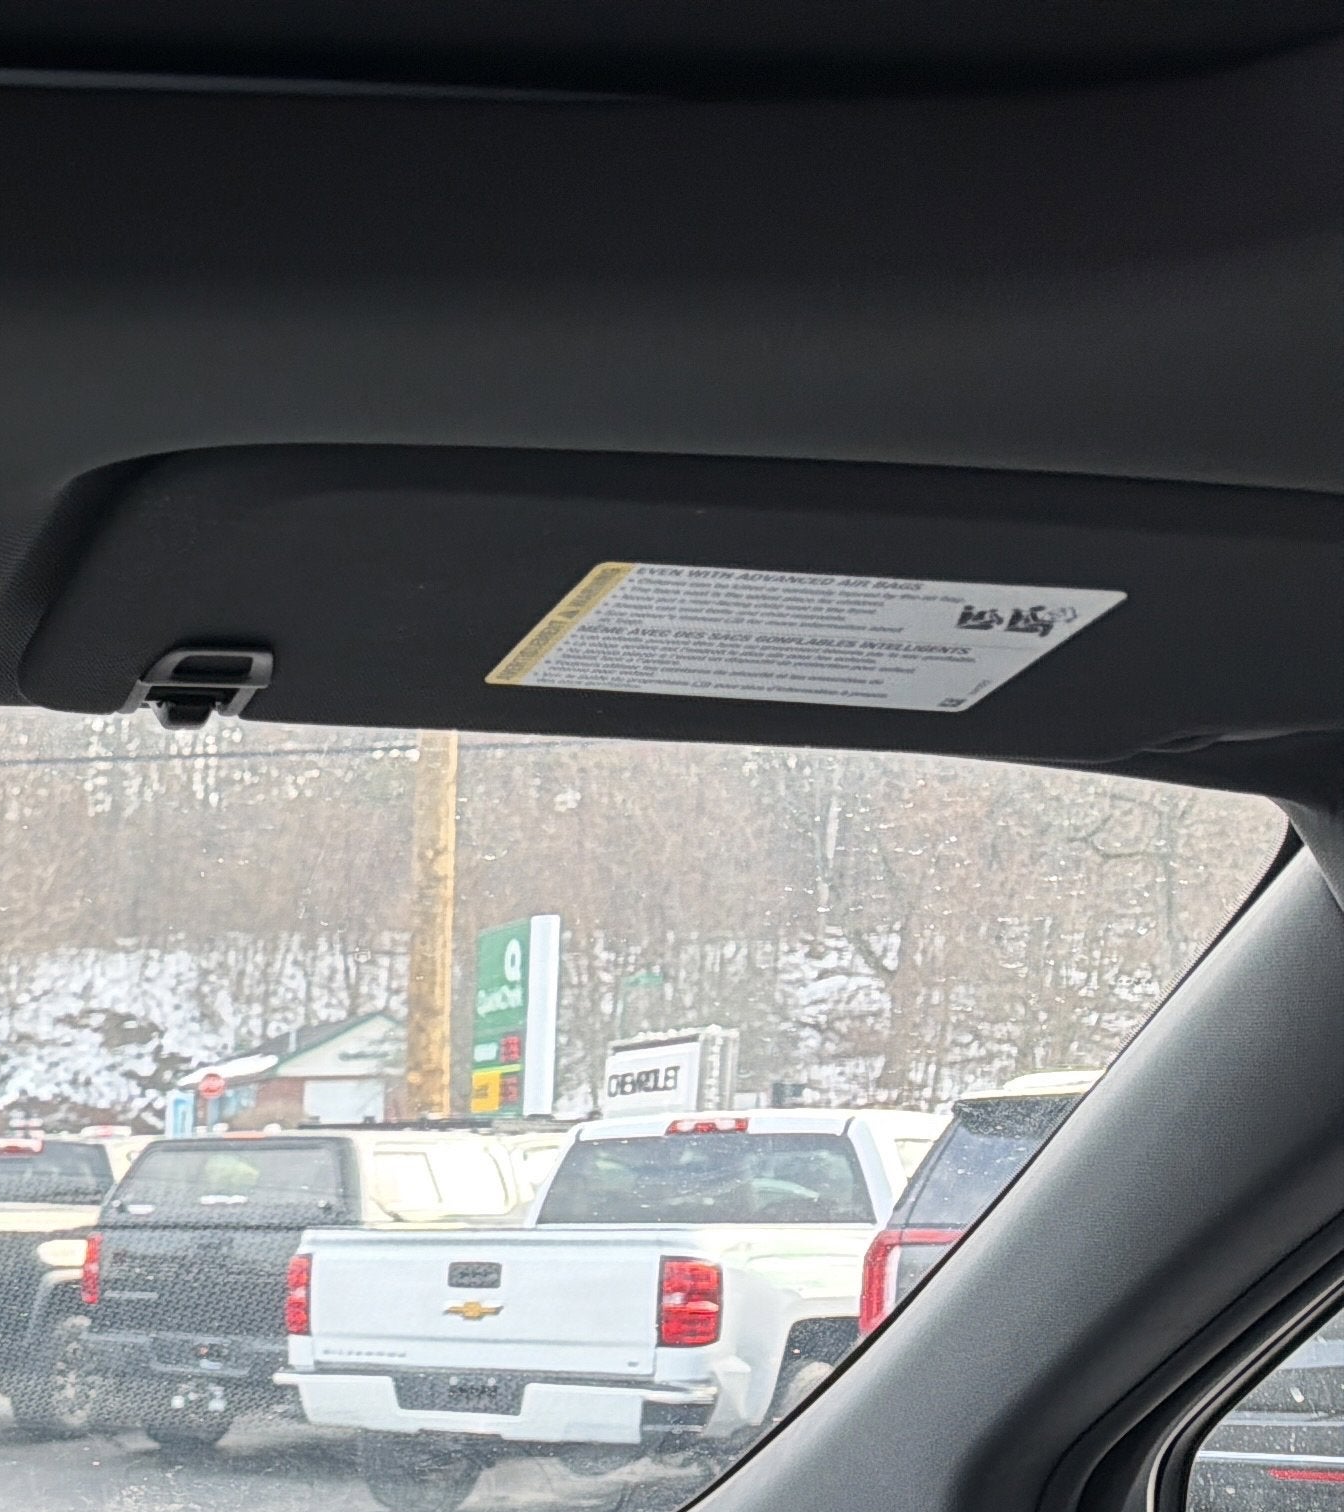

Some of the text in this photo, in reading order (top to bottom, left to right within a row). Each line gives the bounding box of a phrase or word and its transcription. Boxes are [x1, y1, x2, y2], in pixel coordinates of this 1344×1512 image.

[636, 566, 683, 577] EVEN
[687, 568, 737, 579] WITH
[739, 570, 834, 585] ADVANCED
[840, 579, 871, 589] AIR
[872, 580, 924, 591] BAGS
[628, 626, 670, 637] AVEC
